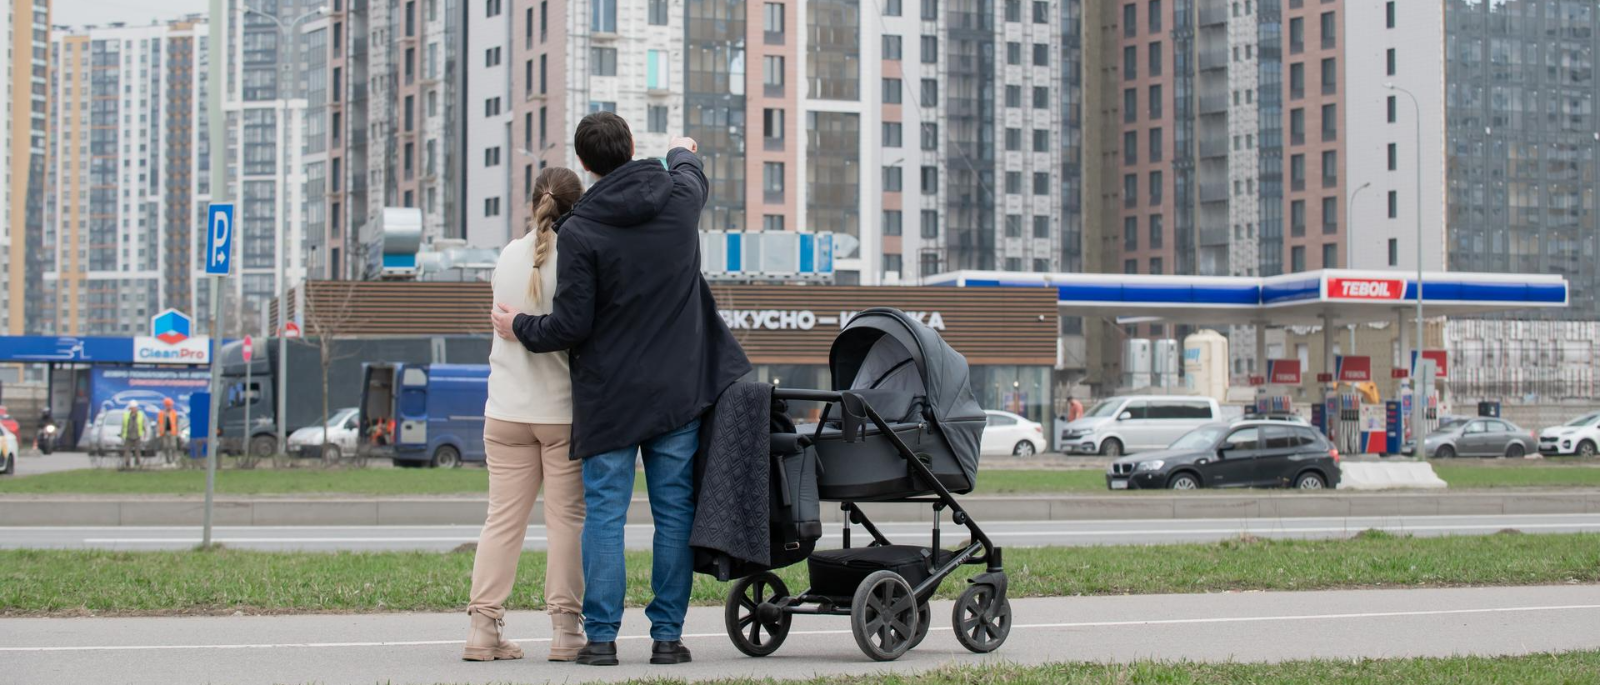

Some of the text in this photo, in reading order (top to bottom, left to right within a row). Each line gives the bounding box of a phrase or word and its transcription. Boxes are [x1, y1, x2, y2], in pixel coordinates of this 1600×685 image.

[211, 210, 229, 268] P
[1341, 281, 1391, 297] TEBOIL
[718, 310, 815, 330] ВКУСНО
[139, 348, 204, 359] CleanPro
[1275, 373, 1298, 382] TEBOIL
[1344, 370, 1368, 379] TEBOIL
